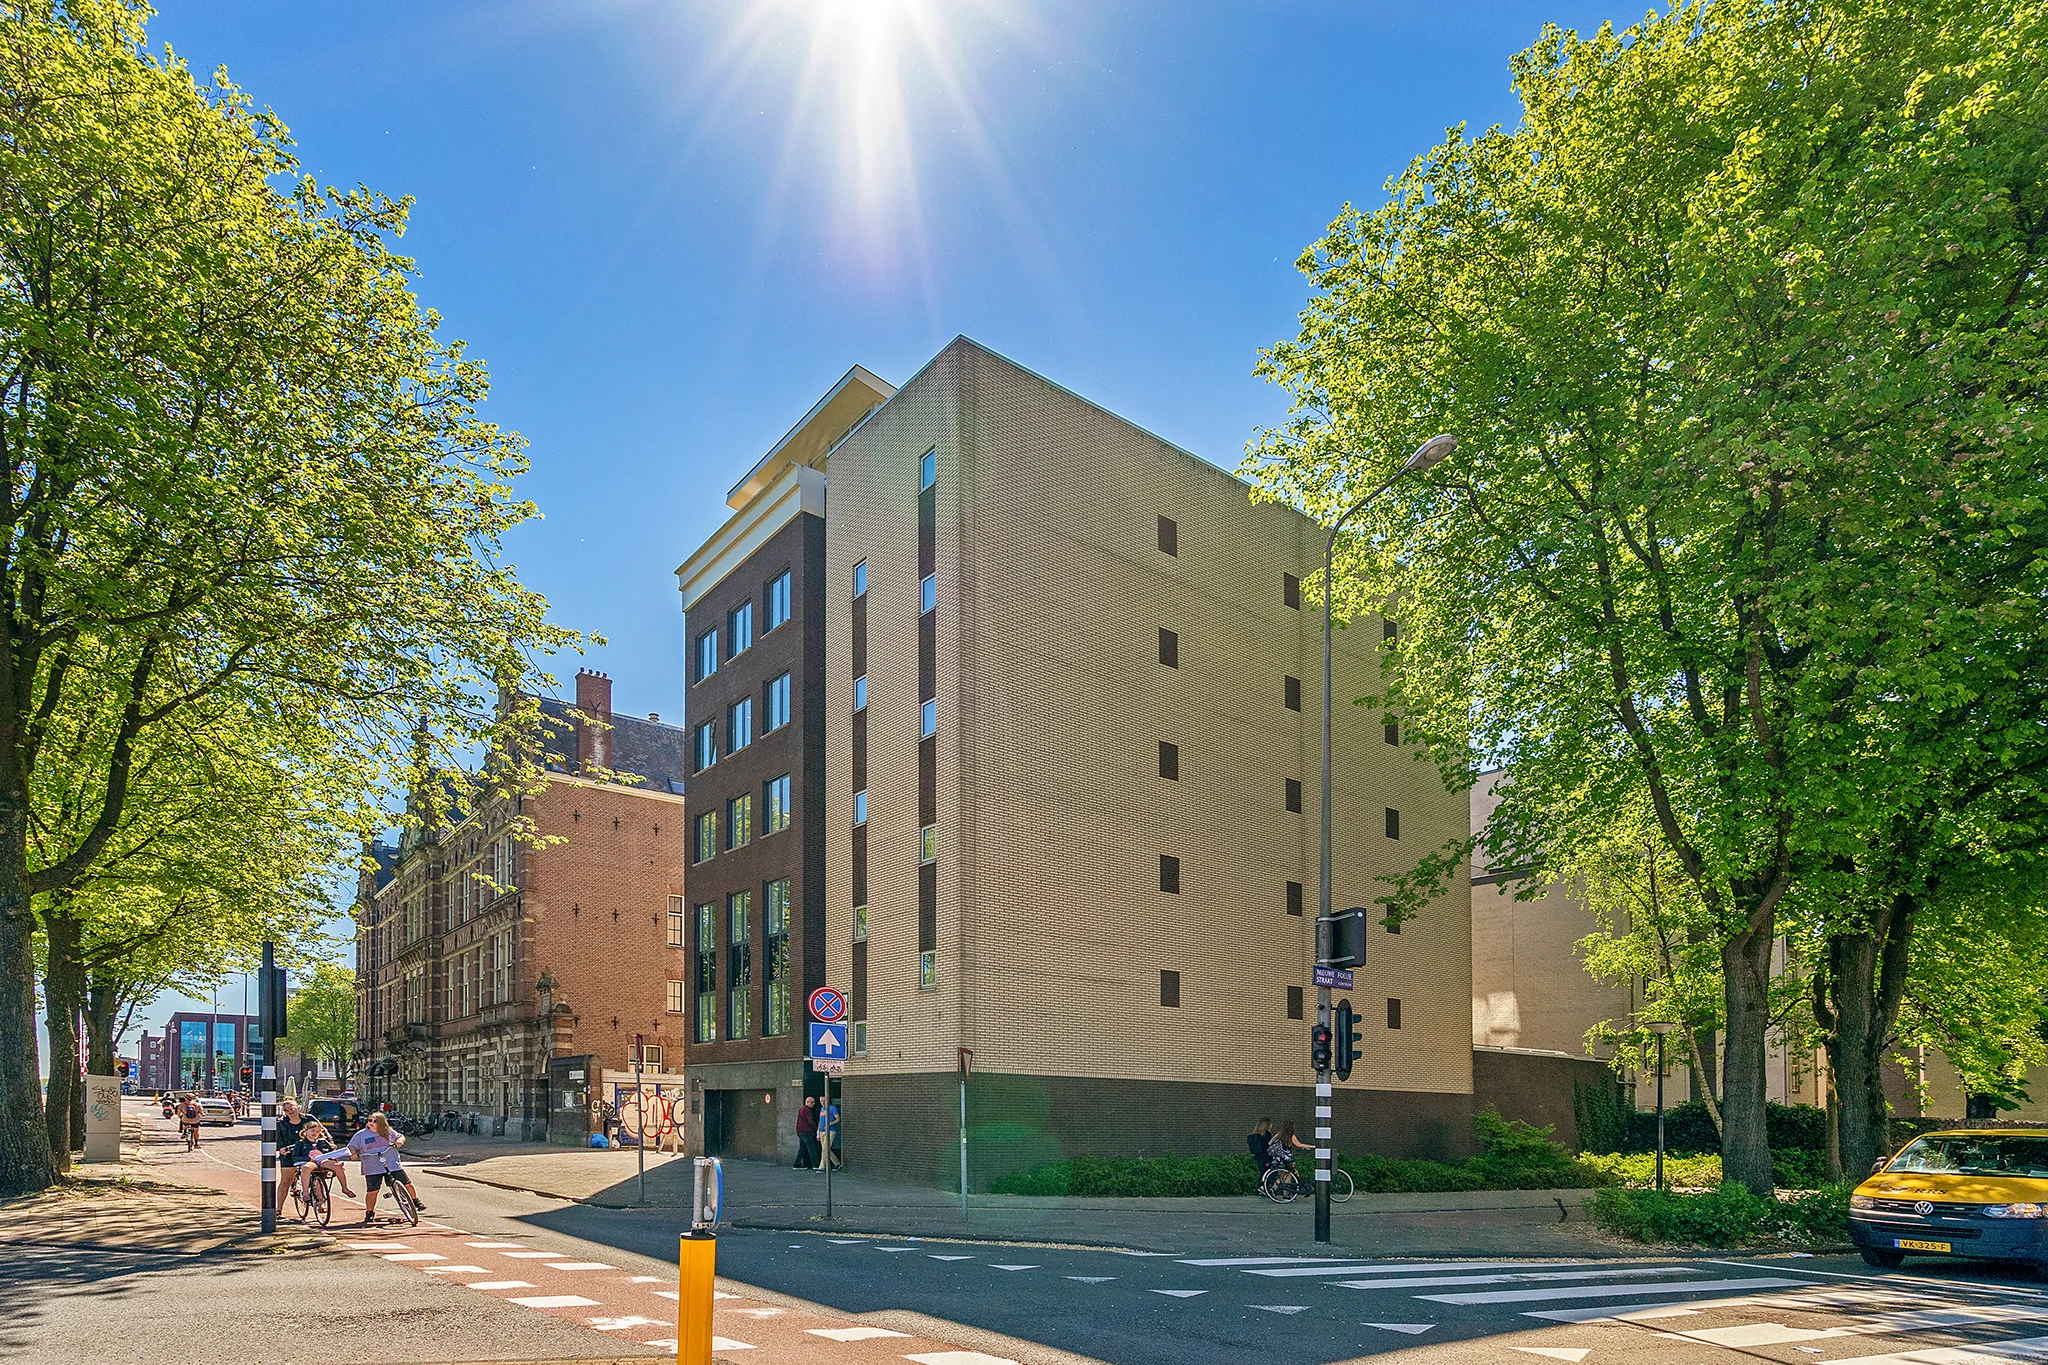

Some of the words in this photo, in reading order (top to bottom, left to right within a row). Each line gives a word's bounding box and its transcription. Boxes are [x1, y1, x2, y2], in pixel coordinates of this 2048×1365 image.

[1316, 969, 1335, 978] NIEUWE
[1337, 972, 1352, 980] FOELIE
[1316, 976, 1333, 984] STRAAT
[1902, 1240, 1946, 1251] VK-325-F
